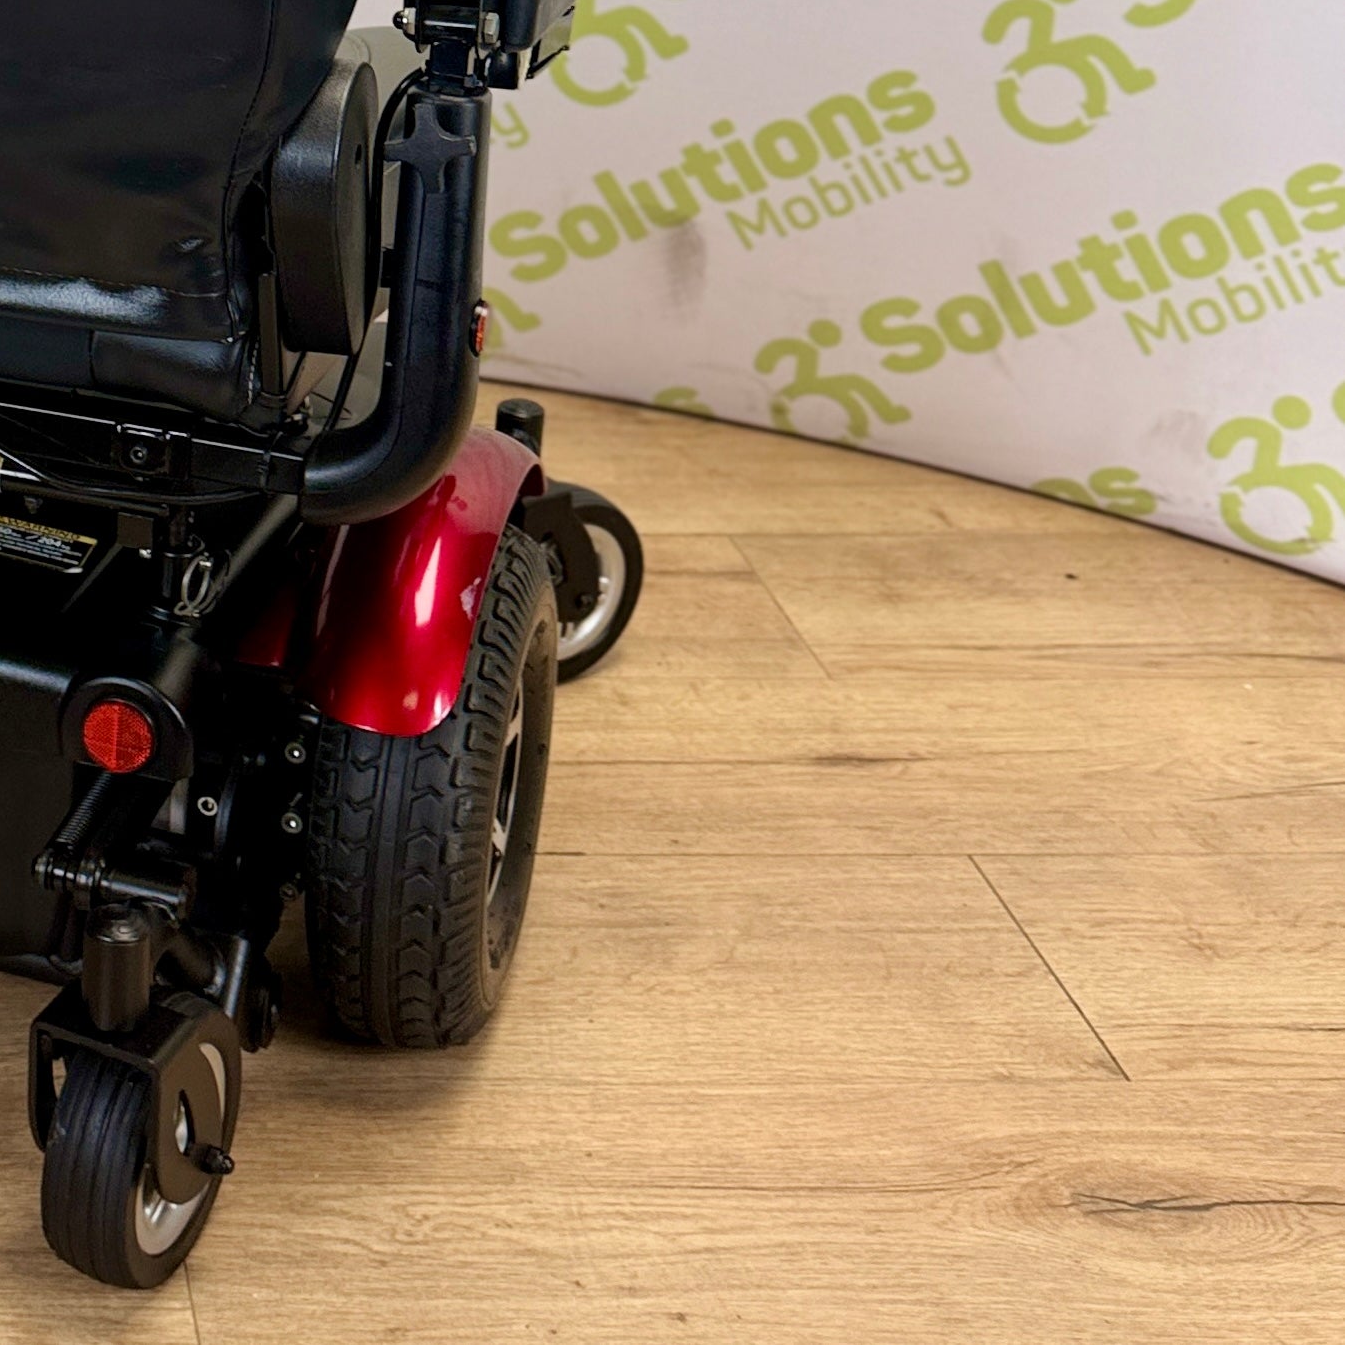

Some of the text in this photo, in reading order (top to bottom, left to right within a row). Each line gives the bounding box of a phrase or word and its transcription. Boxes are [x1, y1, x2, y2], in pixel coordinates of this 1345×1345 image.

[489, 70, 935, 282] Solutions
[726, 135, 972, 251] Mobility
[860, 163, 1345, 373] Solutions
